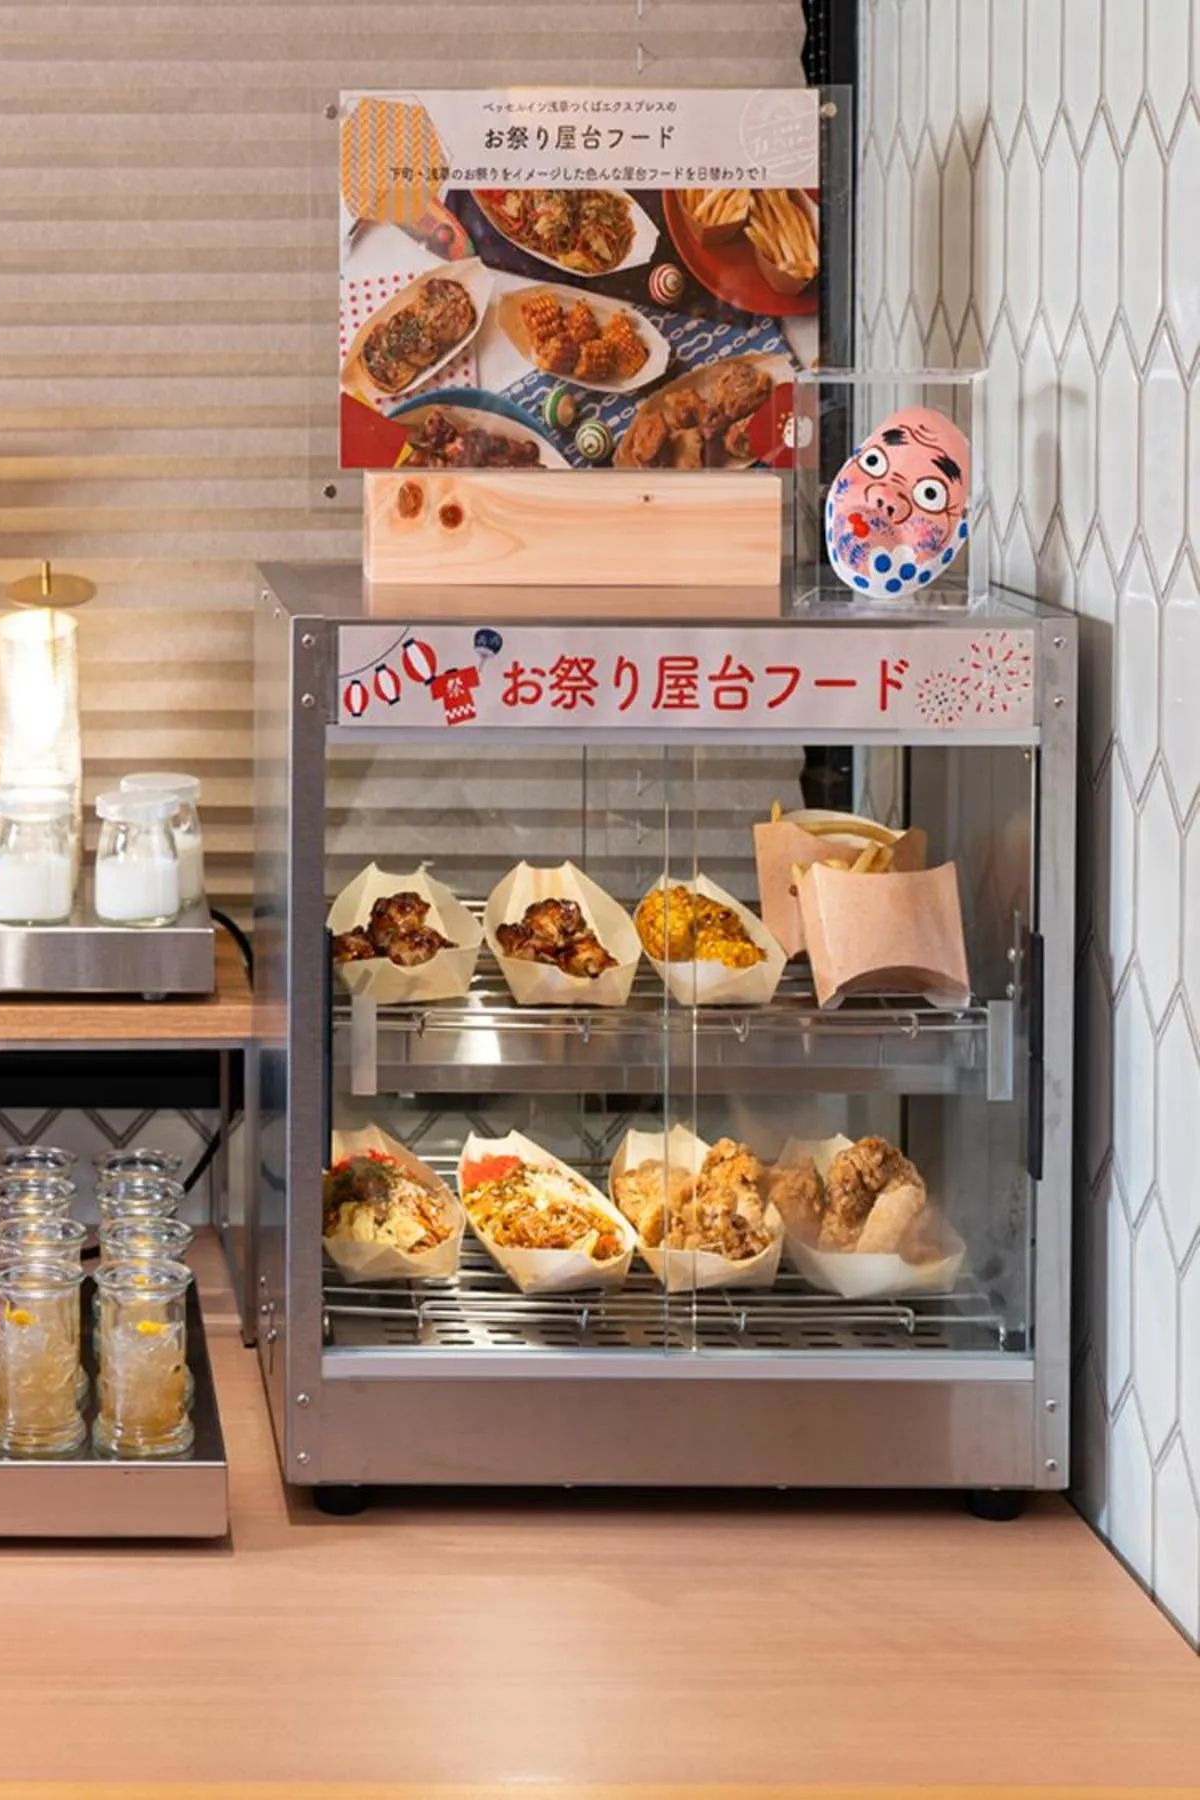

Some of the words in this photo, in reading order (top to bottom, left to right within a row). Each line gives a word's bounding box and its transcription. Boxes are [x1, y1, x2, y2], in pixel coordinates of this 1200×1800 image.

[484, 124, 675, 150] お祭り屋台フード
[501, 653, 910, 713] お祭り屋台フード
